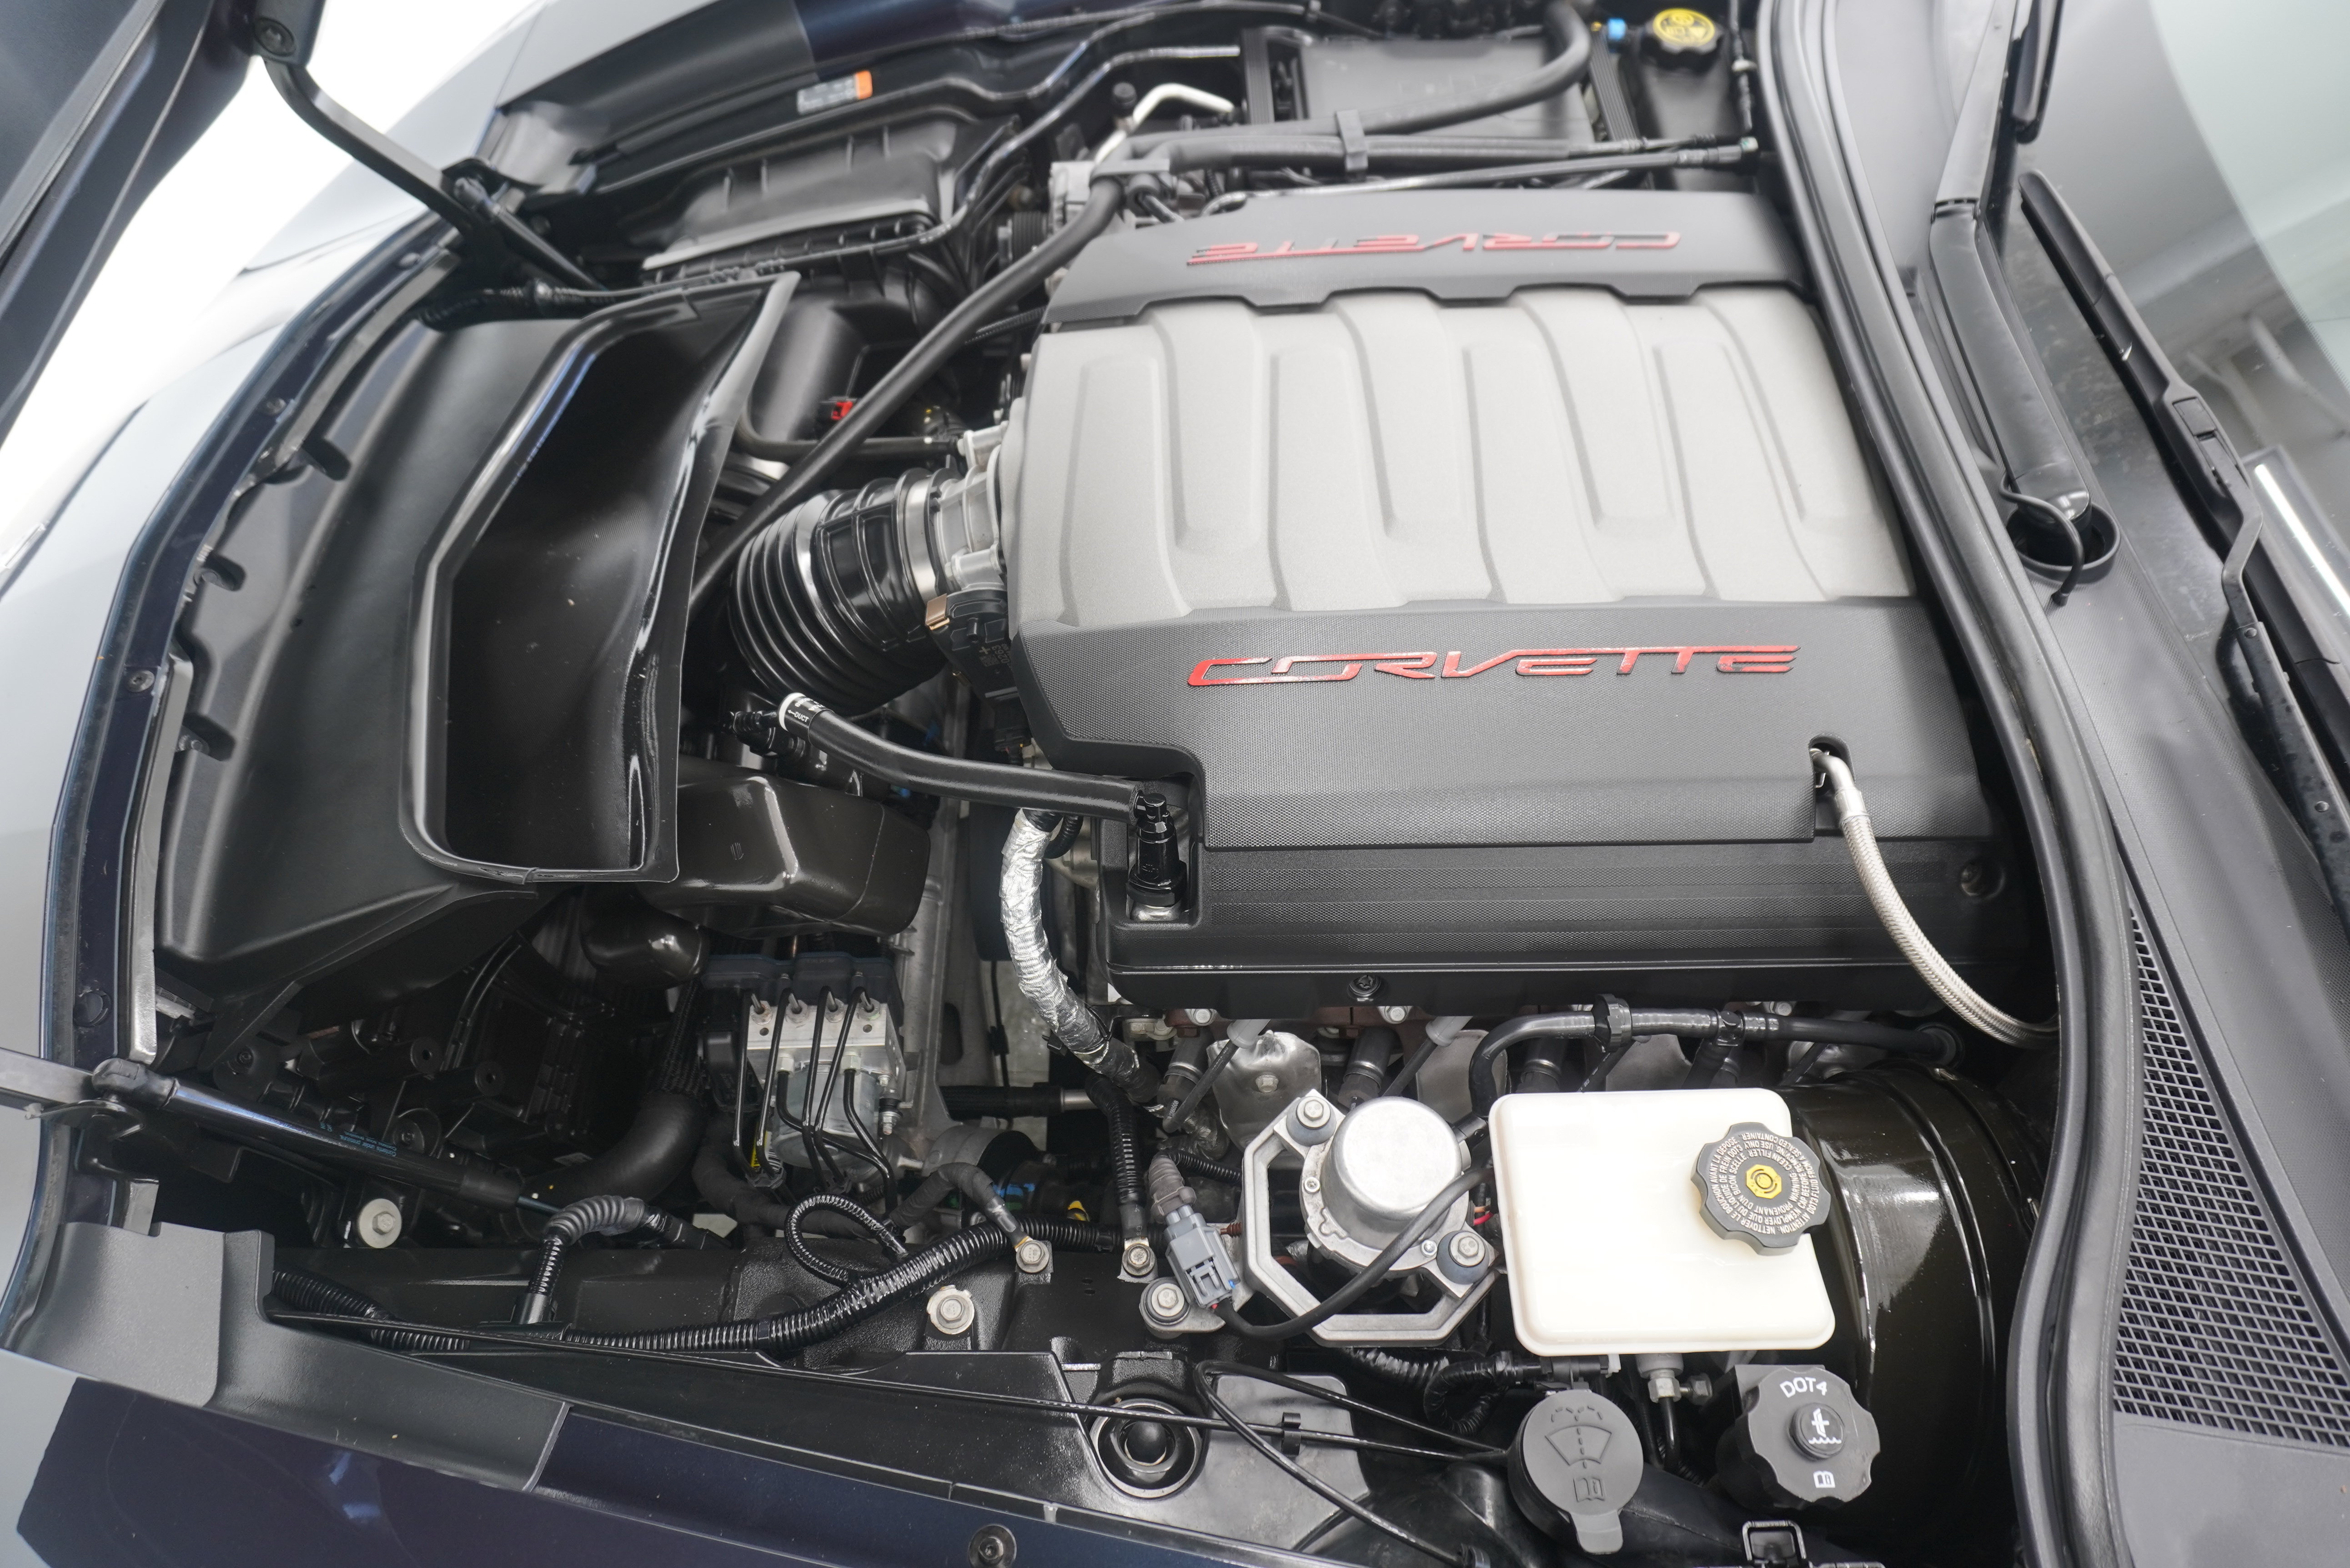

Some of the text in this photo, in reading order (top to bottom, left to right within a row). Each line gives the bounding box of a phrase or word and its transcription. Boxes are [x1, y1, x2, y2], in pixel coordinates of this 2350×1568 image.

[1188, 232, 1680, 265] CORVETTE
[1187, 645, 1800, 686] CORVETTE
[794, 711, 809, 723] DUCT
[1739, 1132, 1778, 1143] CONTAINER.
[1778, 1139, 1801, 1157] SEALED
[1744, 1141, 1810, 1209] CAP BEFORE REMOVING. USE ONLY
[1748, 1149, 1800, 1202] WARNING: CLEAN FILLER
[1802, 1161, 1817, 1178] FROM
[1710, 1137, 1810, 1235] ATTENTION: NETTOYER LE BOUCHON AVANT LA DEPOSE.
[1719, 1145, 1802, 1225] N'EMPLOYER QUE DU LIQUIDE DE FREIN DOT3
[1728, 1153, 1793, 1216] PROVENANT D'UN BIDON SCELLE.
[1810, 1179, 1819, 1198] FLUID
[1806, 1197, 1818, 1215] DOT3
[1780, 1377, 1827, 1398] DOT4
